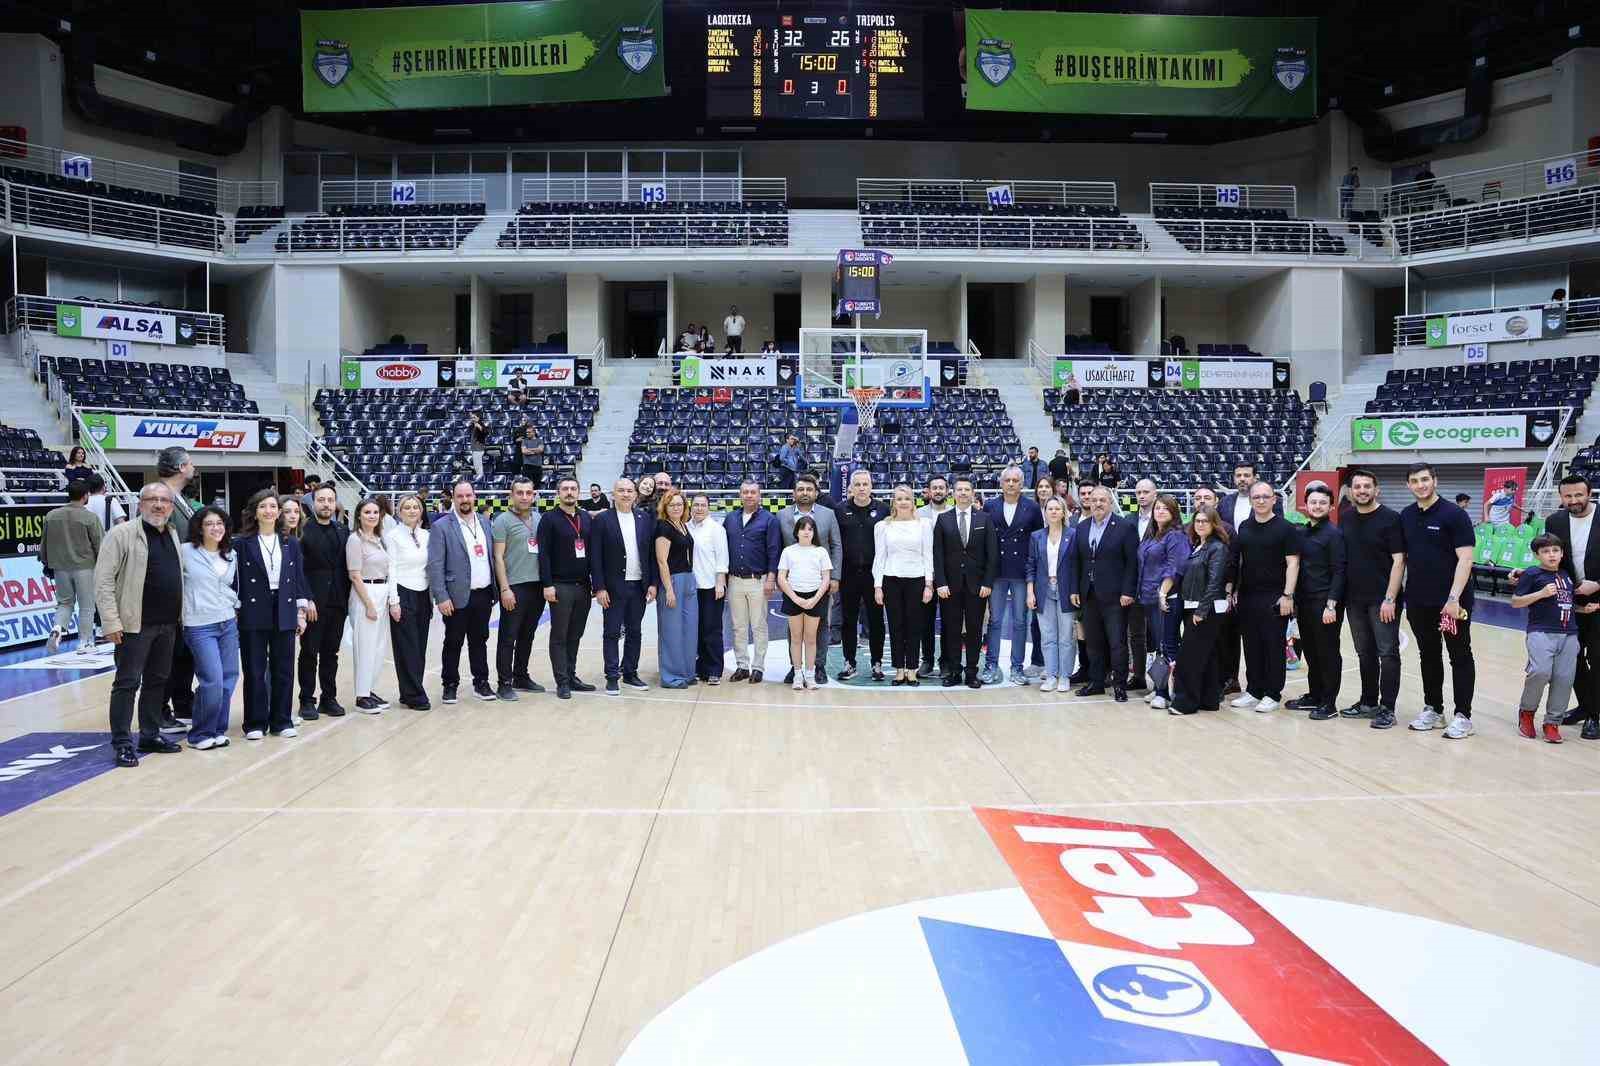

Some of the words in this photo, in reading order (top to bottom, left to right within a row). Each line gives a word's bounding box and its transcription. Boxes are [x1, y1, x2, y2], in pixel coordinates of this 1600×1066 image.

[856, 14, 896, 27] TRIPOLIS
[783, 30, 803, 46] 32
[831, 30, 850, 46] 26
[392, 39, 568, 75] #ŞEHRİNEFENDİLERİ
[799, 55, 837, 71] 15:00
[1055, 53, 1223, 82] #BUŞEHRİNTAKIMI
[810, 81, 819, 94] 3
[63, 158, 91, 178] H1
[1545, 164, 1575, 184] H6
[392, 185, 415, 201] H2
[642, 186, 666, 202] H3
[988, 188, 1012, 206] H4
[1216, 187, 1239, 204] H5
[848, 266, 875, 277] 15:00
[108, 316, 163, 334] ALSA
[112, 344, 127, 356] D1
[1467, 347, 1484, 359] D5
[728, 366, 766, 376] NAK
[1167, 366, 1181, 376] D4
[145, 422, 198, 436] YUKA
[1423, 426, 1520, 443] ecogreen
[15, 515, 47, 540] BAS
